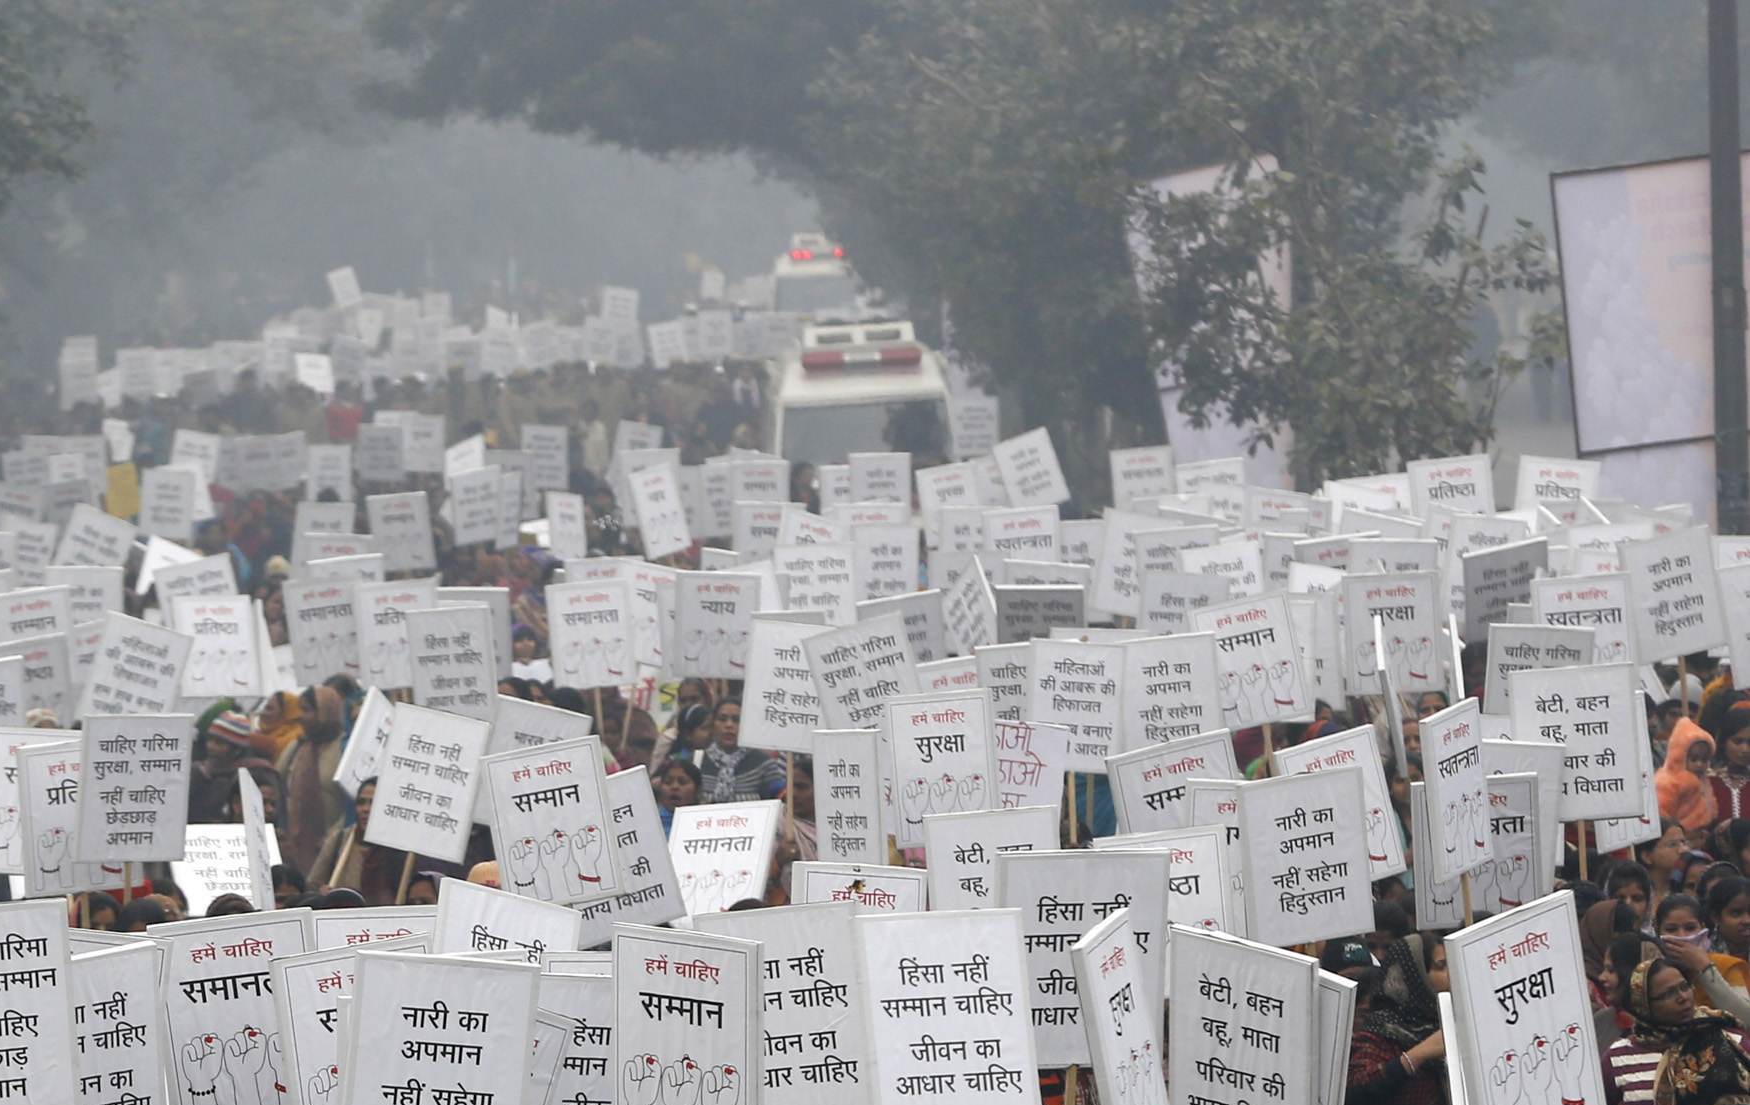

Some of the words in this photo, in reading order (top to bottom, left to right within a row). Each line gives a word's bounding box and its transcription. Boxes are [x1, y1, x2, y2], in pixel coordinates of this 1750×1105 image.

[1217, 628, 1275, 652] सम्मान
[865, 652, 905, 671] सम्मान
[1054, 658, 1105, 676] महिलाओं
[1060, 681, 1096, 693] आबरू
[1146, 681, 1191, 695] अपमान
[1053, 695, 1101, 713] हिफाजत
[1576, 696, 1609, 711] बहन
[911, 712, 927, 726] हमें
[932, 709, 964, 723] चाहिए
[1574, 722, 1608, 736] माता
[98, 735, 137, 754] चाहिए
[142, 733, 178, 751] गरिमा
[408, 734, 436, 754] हिंसा
[440, 744, 463, 761] नहीं
[914, 734, 964, 763] सुरक्षा
[93, 761, 132, 780] सुरक्षा,
[139, 759, 181, 772] सम्मान
[392, 756, 430, 775] सम्मान
[435, 764, 469, 786] चाहिए
[512, 766, 530, 782] हमें
[535, 760, 572, 776] चाहिए
[1438, 745, 1479, 778] स्वतन्त्रता
[1595, 751, 1615, 767] की
[100, 786, 124, 805] नहीं
[128, 785, 166, 804] चाहिए
[399, 783, 432, 804] जीवन
[436, 795, 452, 809] का
[1574, 776, 1623, 794] विधाता
[512, 784, 580, 812] सम्मान
[384, 804, 420, 822] आधार
[425, 812, 458, 834] चाहिए
[1275, 808, 1306, 831] नारी
[1312, 808, 1333, 823] का
[106, 832, 153, 845] अपमान
[683, 836, 754, 854] समानता
[1280, 832, 1334, 854] अपमान
[1272, 866, 1301, 888] नहीं
[1305, 861, 1347, 882] सहेगा
[190, 943, 215, 963] हमें
[222, 938, 273, 957] चाहिए
[1487, 946, 1506, 970] हमें
[1510, 932, 1549, 957] चाहिए
[645, 955, 668, 975] हमें
[674, 959, 720, 984] चाहिए
[898, 957, 944, 987] हिंसा
[951, 954, 989, 983] नहीं
[881, 997, 946, 1018] सम्मान
[953, 987, 1013, 1016] चाहिए
[1199, 973, 1237, 1009] बेटी,
[1246, 992, 1284, 1018] बहन
[1494, 967, 1554, 1025] सुरक्षा
[402, 1001, 449, 1029] नारी
[458, 1012, 489, 1032] का
[639, 992, 724, 1029] सम्मान
[1201, 1017, 1232, 1048] बहू,
[1241, 1027, 1280, 1053] माता
[402, 1041, 483, 1065] अपमान
[909, 1035, 966, 1062] जीवन
[974, 1039, 1000, 1058] का
[897, 1075, 955, 1095] आधार
[963, 1064, 1022, 1093] चाहिए
[1195, 1057, 1256, 1092] परिवार
[1262, 1073, 1285, 1100] की
